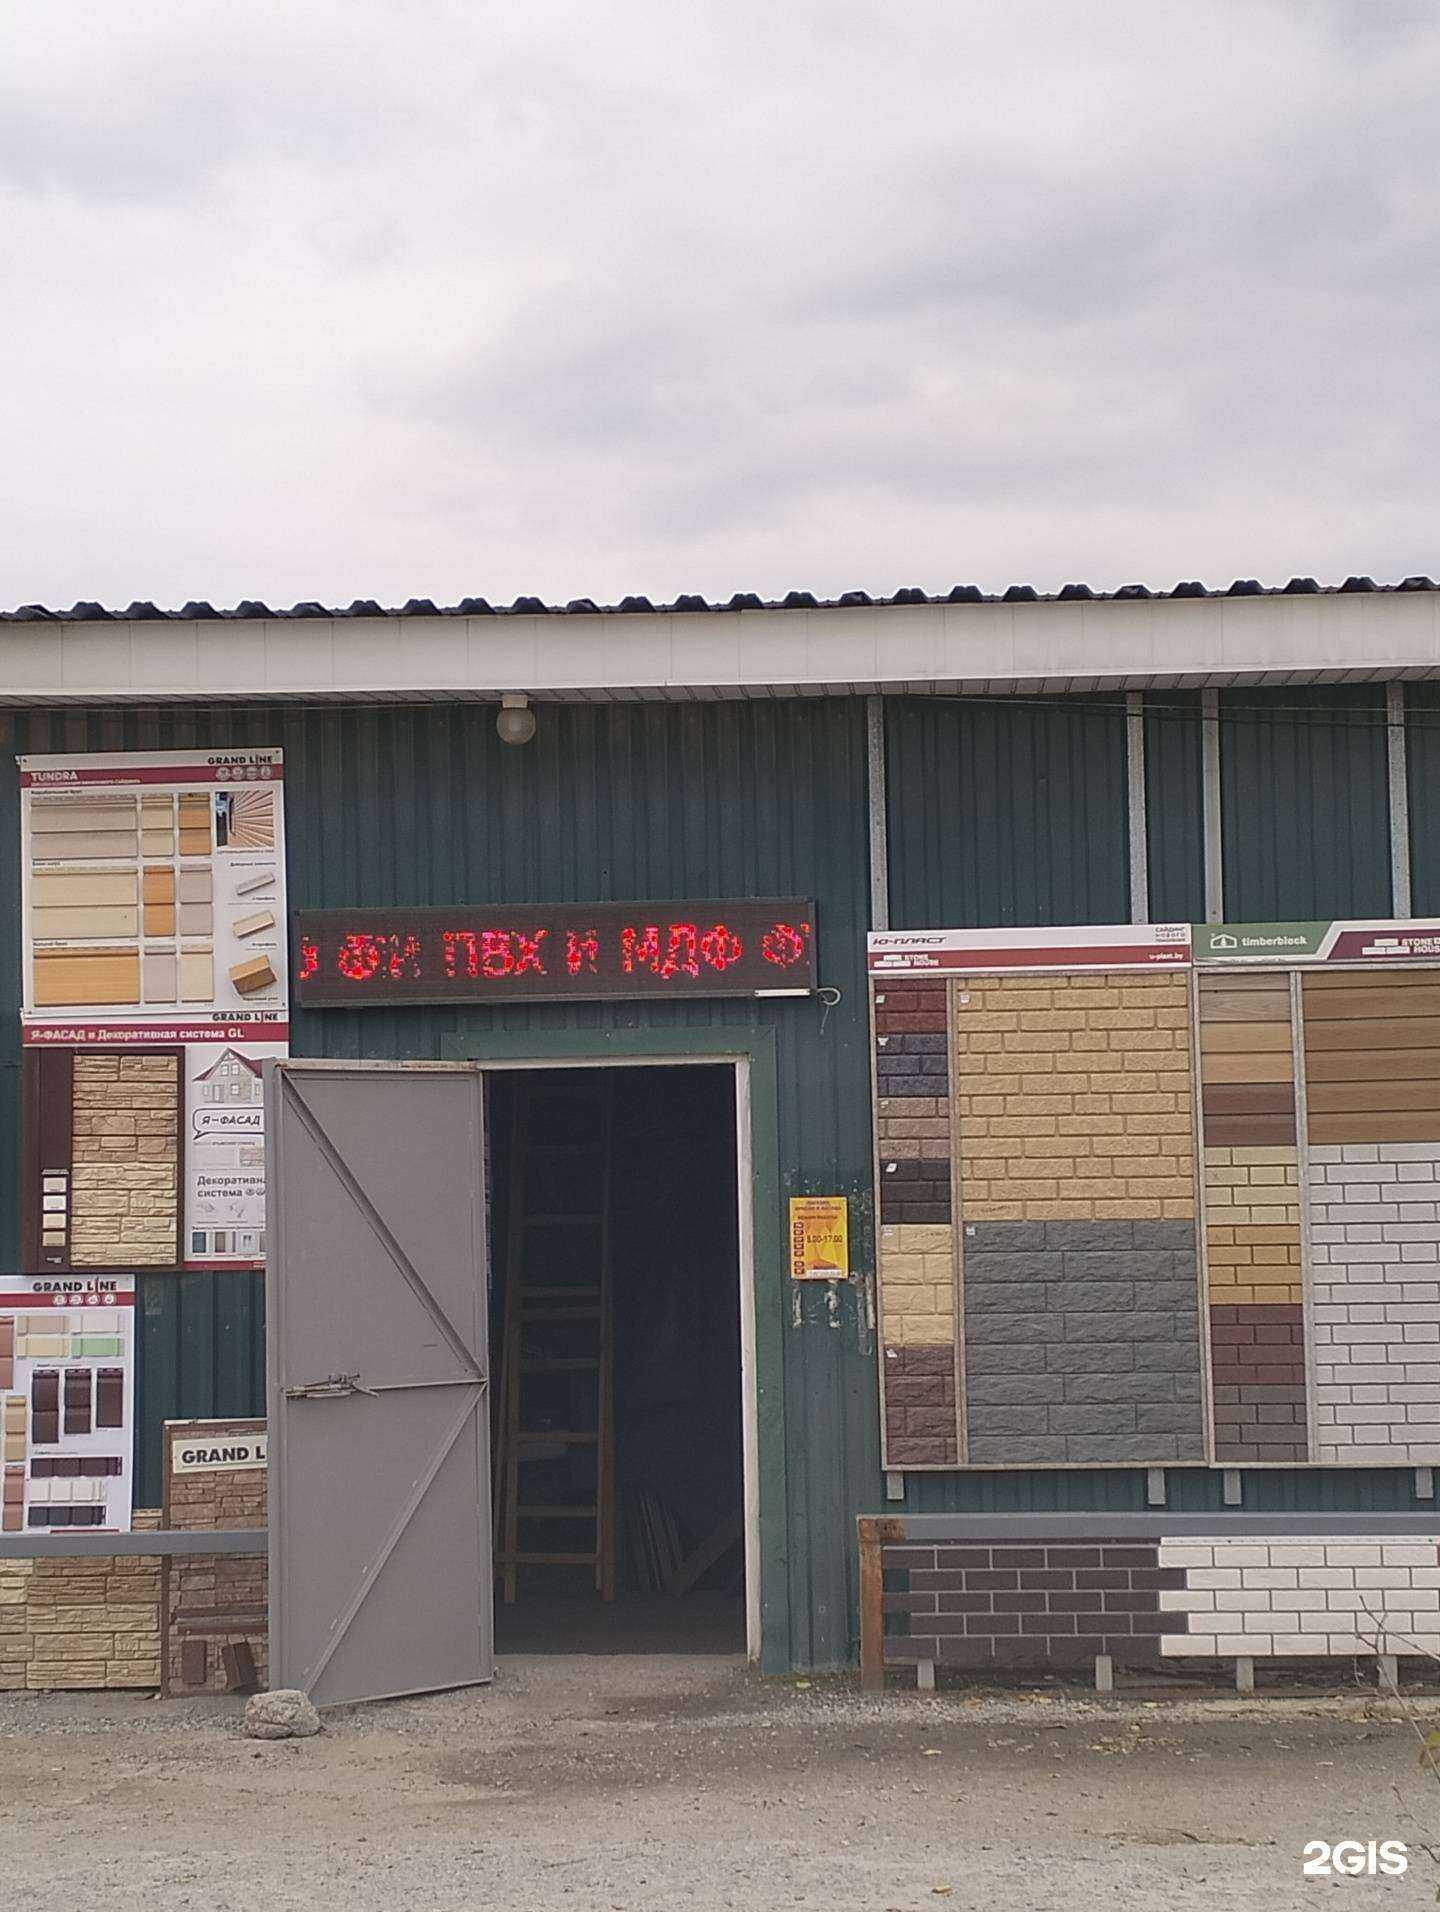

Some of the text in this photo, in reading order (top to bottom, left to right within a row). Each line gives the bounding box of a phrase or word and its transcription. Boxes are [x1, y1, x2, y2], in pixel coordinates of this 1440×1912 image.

[207, 754, 273, 765] GRAND LINE
[31, 771, 79, 782] TUNDRA
[442, 929, 549, 979] ПВХ
[620, 924, 743, 980] МДФ
[211, 1011, 279, 1023] GRAND LINE
[31, 1029, 87, 1042] Я-ФАСАД
[97, 1029, 178, 1042] Декоративная
[179, 1030, 226, 1039] система
[227, 1027, 245, 1039] GL
[201, 1115, 261, 1126] Я-ФАСАД
[197, 1175, 266, 1187] Декоративн
[197, 1189, 243, 1198] система
[32, 1276, 117, 1293] GRAND LINE
[181, 1446, 250, 1464] GRAND
